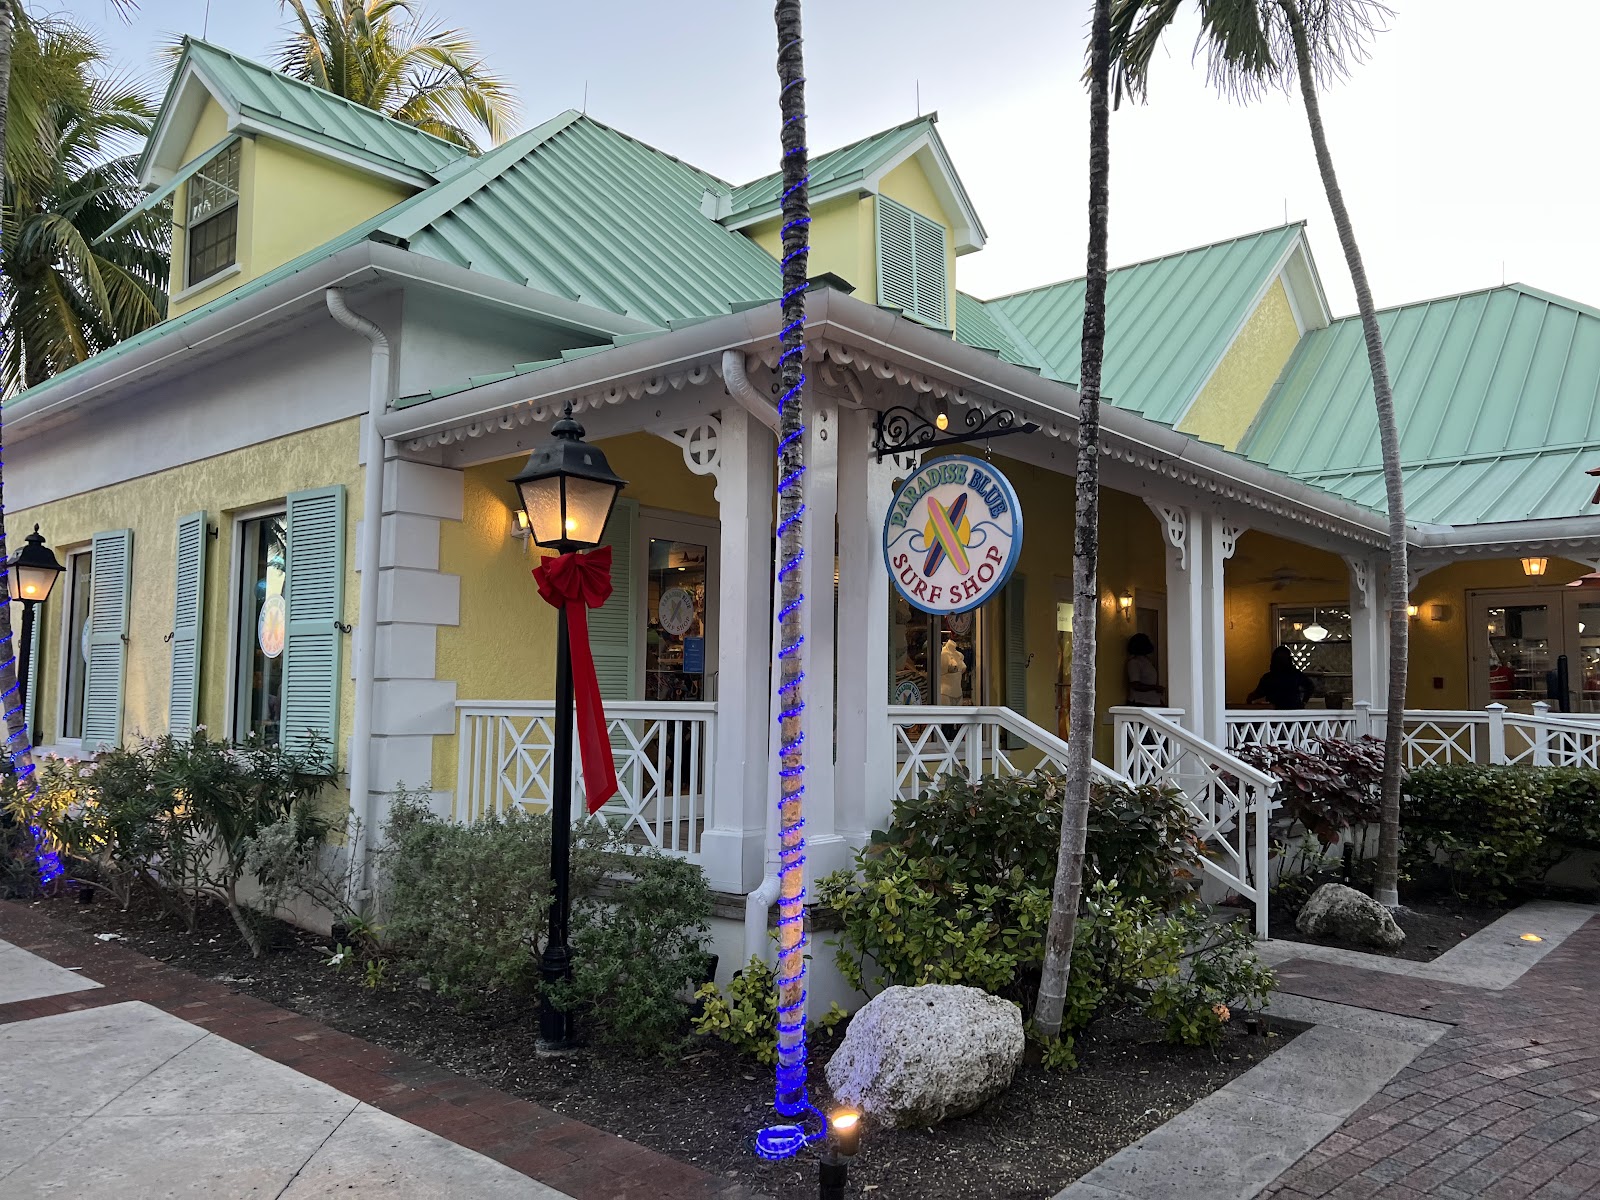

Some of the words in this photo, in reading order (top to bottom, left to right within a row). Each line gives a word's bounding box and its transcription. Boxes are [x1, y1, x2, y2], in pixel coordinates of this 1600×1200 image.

[891, 464, 969, 528] PARADISE
[968, 469, 1009, 519] BLUE
[893, 553, 943, 604] SURF
[949, 545, 1003, 604] SHOP
[676, 616, 690, 632] SHOP
